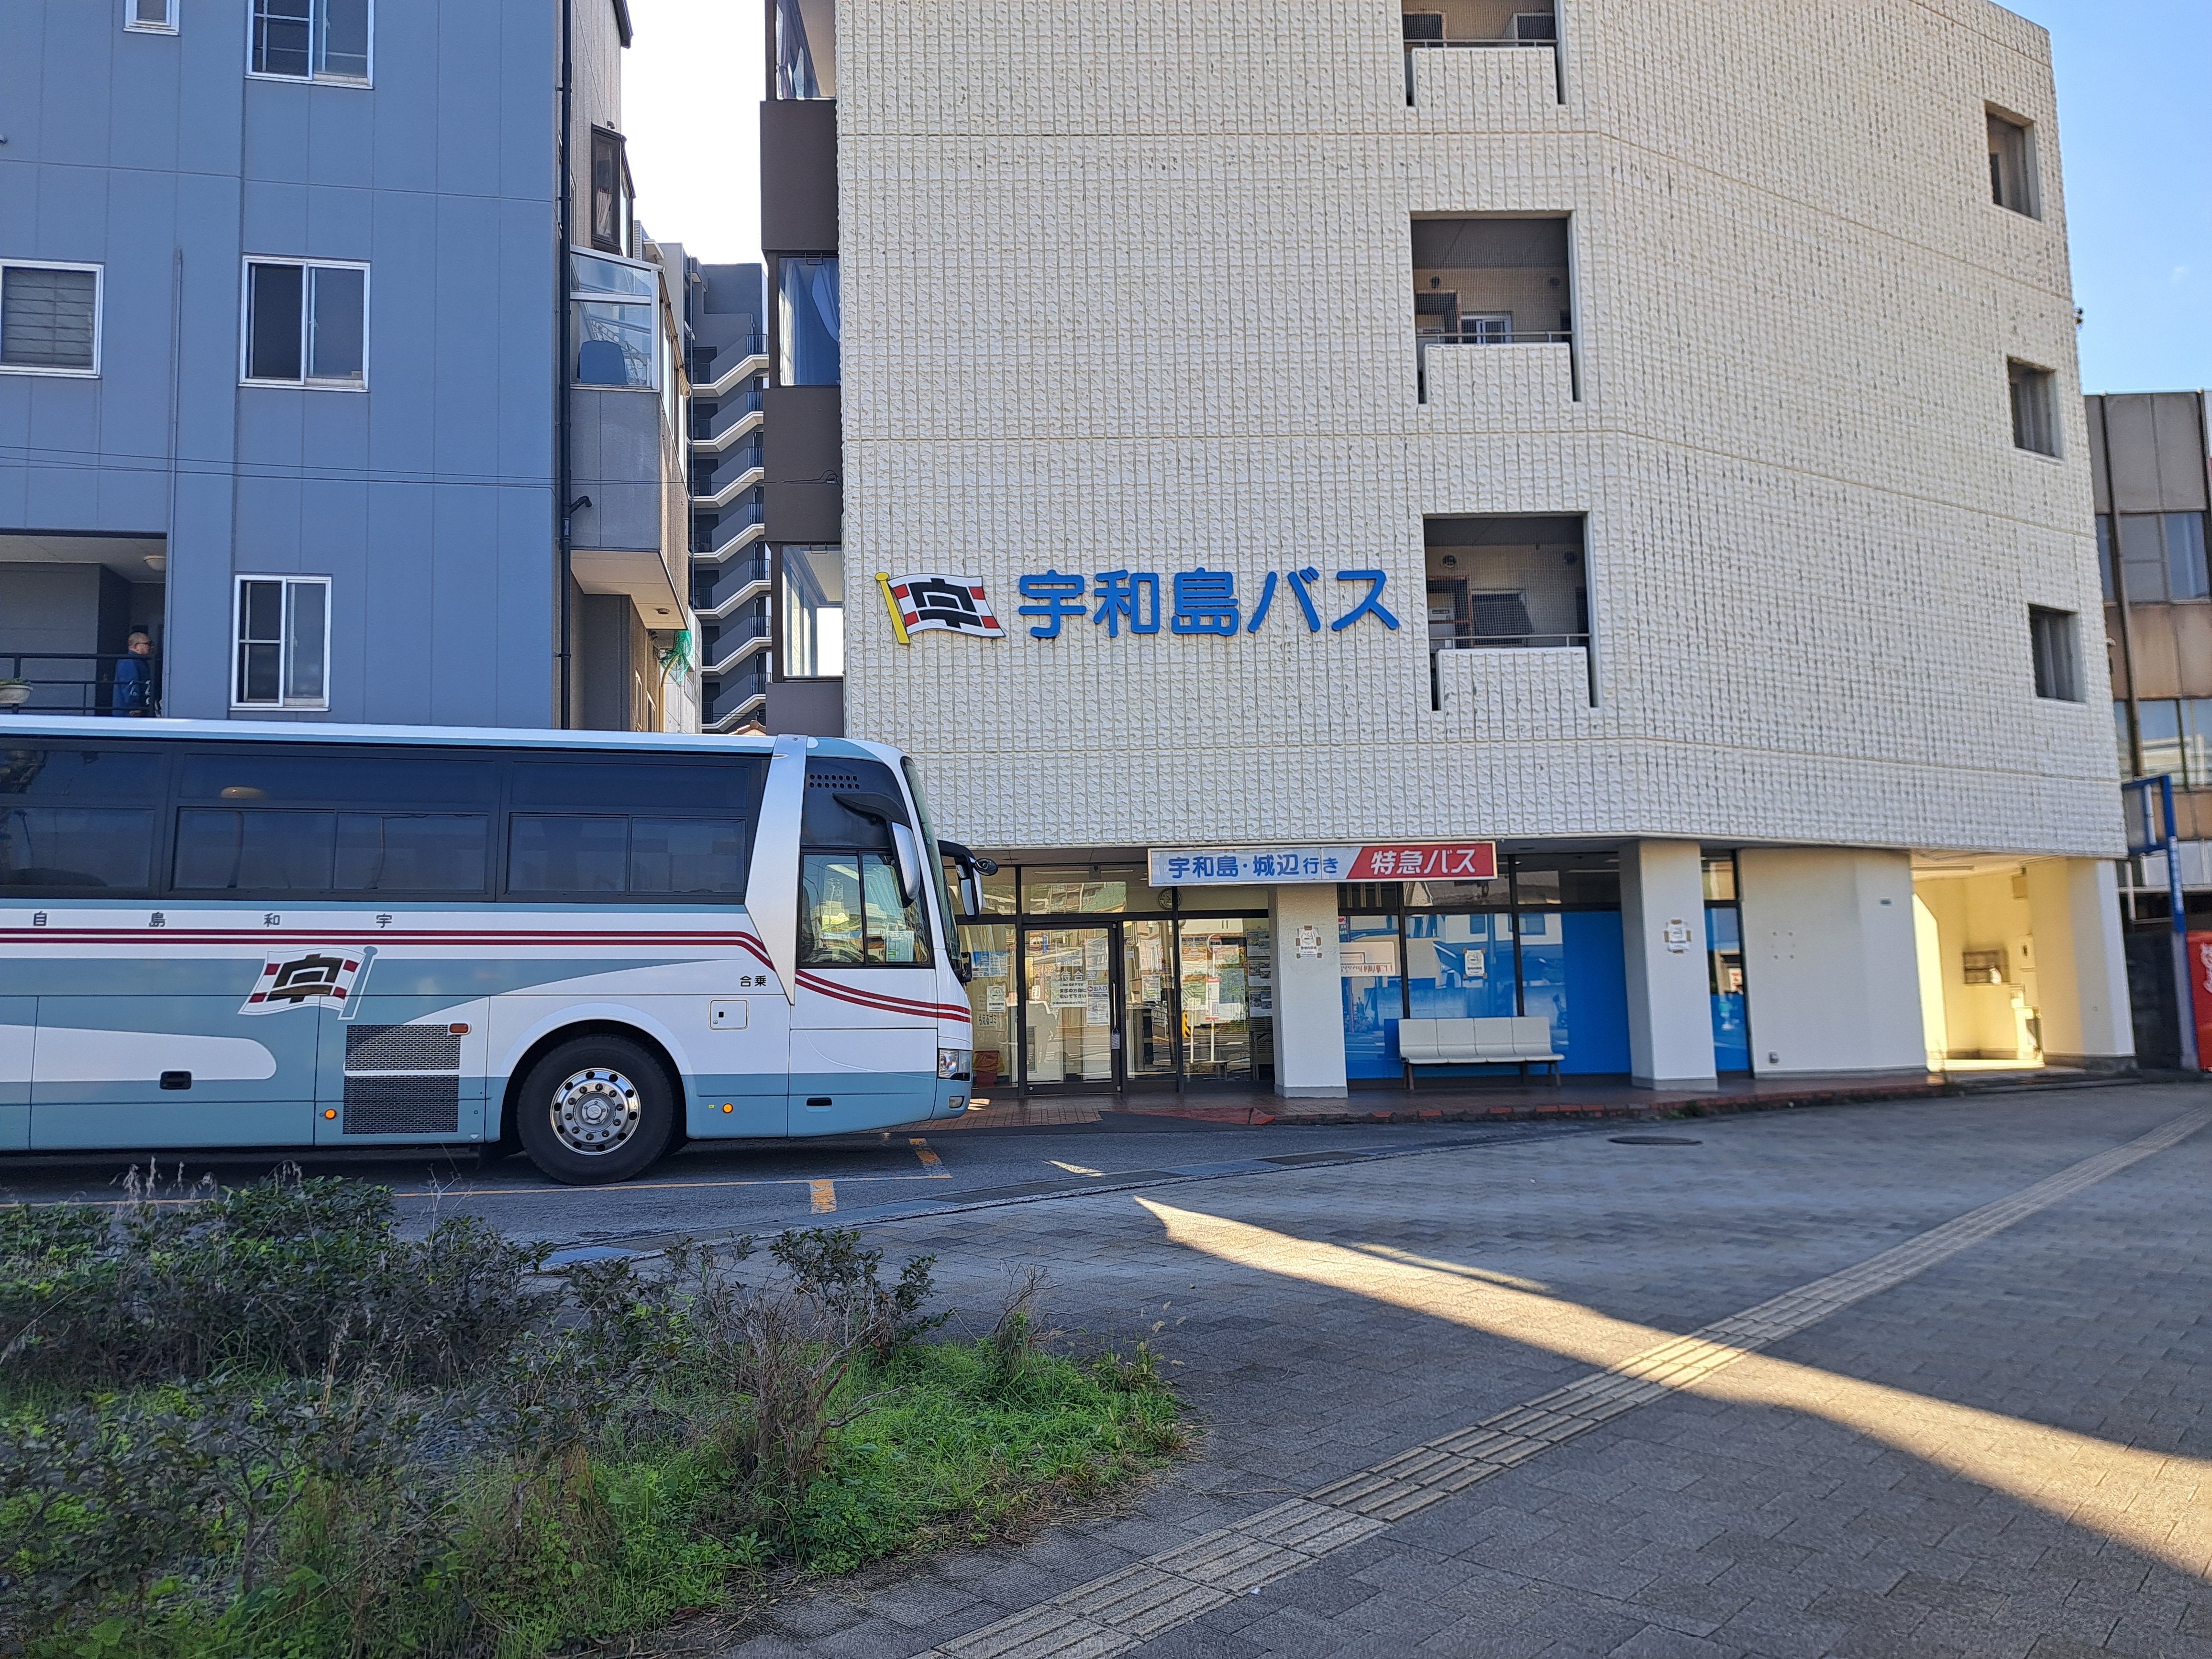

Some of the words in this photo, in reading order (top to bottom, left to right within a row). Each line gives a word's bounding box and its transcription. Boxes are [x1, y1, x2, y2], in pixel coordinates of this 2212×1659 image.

[1018, 566, 1399, 639] 宇和島バス
[1168, 853, 1339, 879] 宇和島・城辺行き
[1370, 848, 1476, 875] 特急バス
[979, 1013, 996, 1025] もえるゴミ
